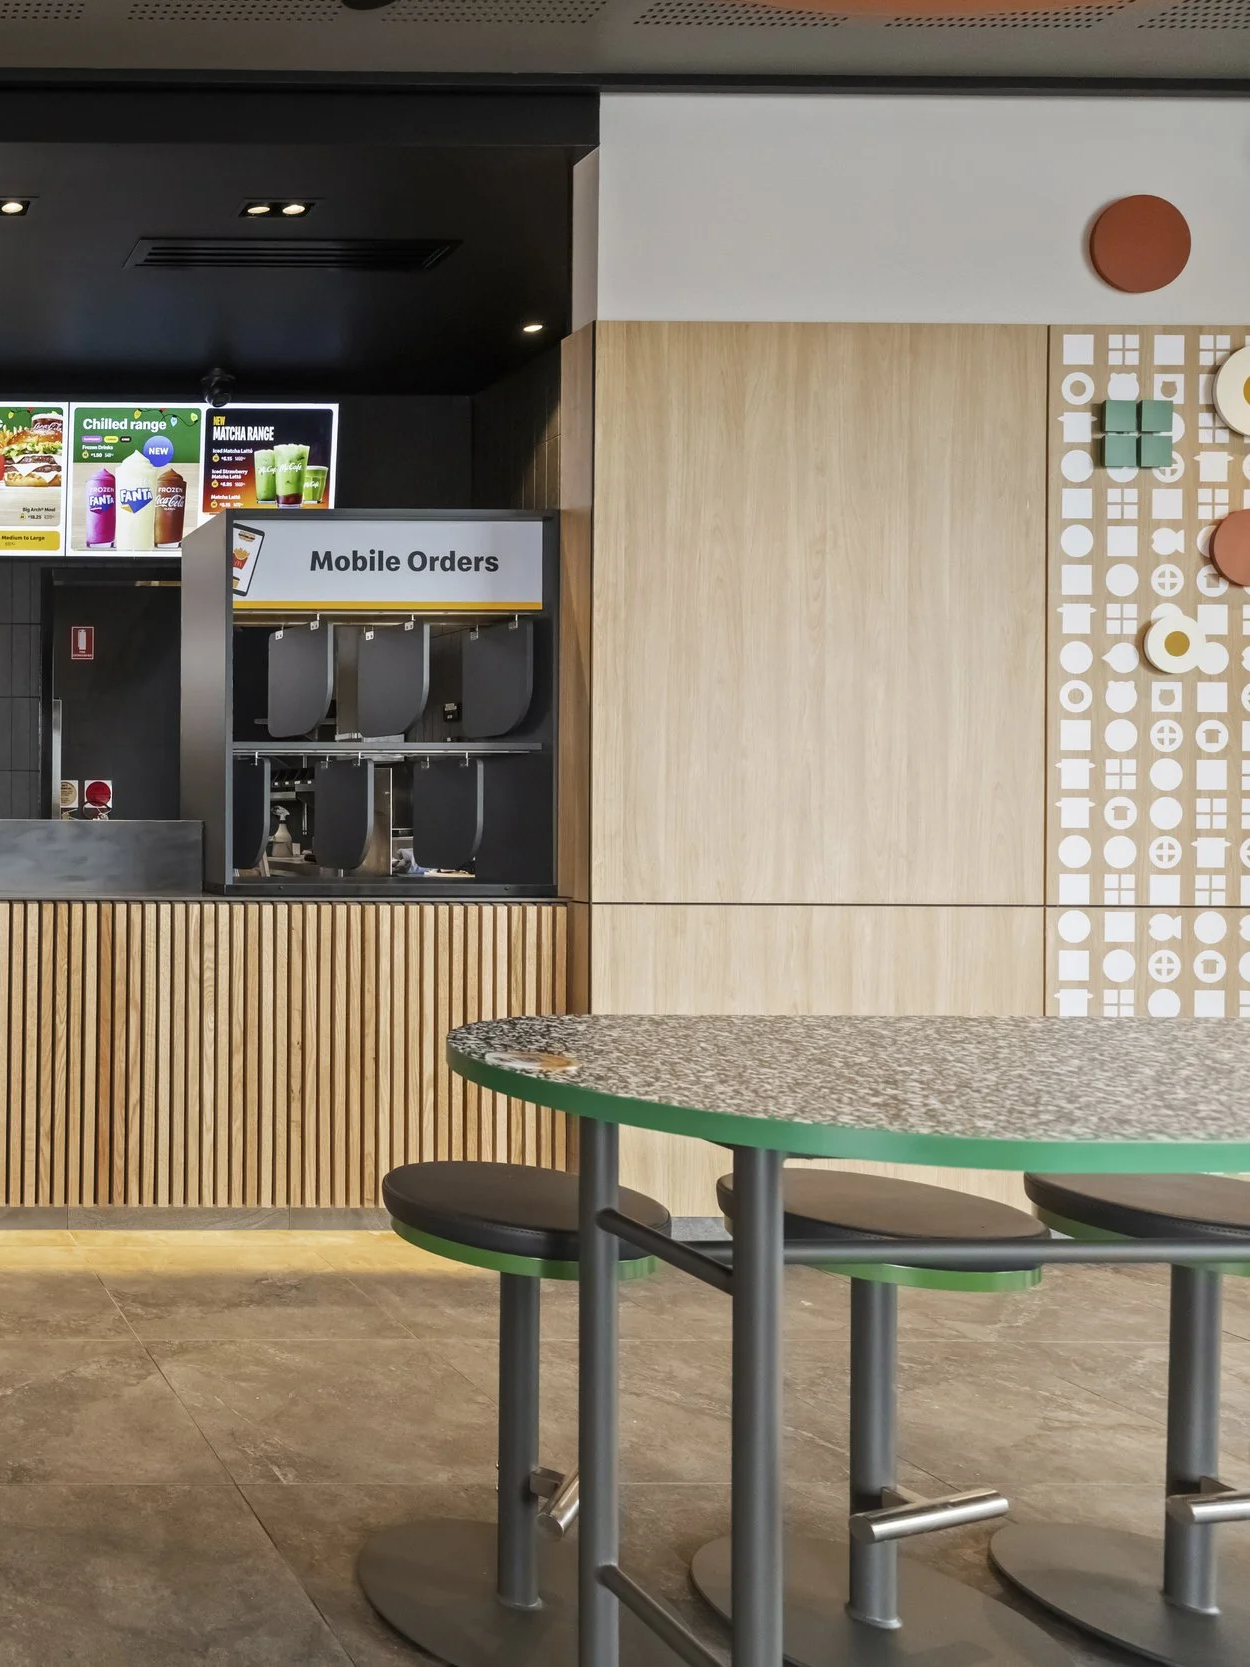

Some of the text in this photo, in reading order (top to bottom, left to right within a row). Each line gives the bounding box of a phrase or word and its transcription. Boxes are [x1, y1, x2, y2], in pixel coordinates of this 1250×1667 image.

[82, 417, 167, 433] Chilled range
[213, 415, 226, 426] NEW
[212, 426, 275, 441] MATCHA RANGE
[148, 447, 169, 456] NEW
[89, 494, 115, 506] FANTA
[120, 487, 153, 503] FANTA
[310, 549, 499, 572] Mobile Orders
